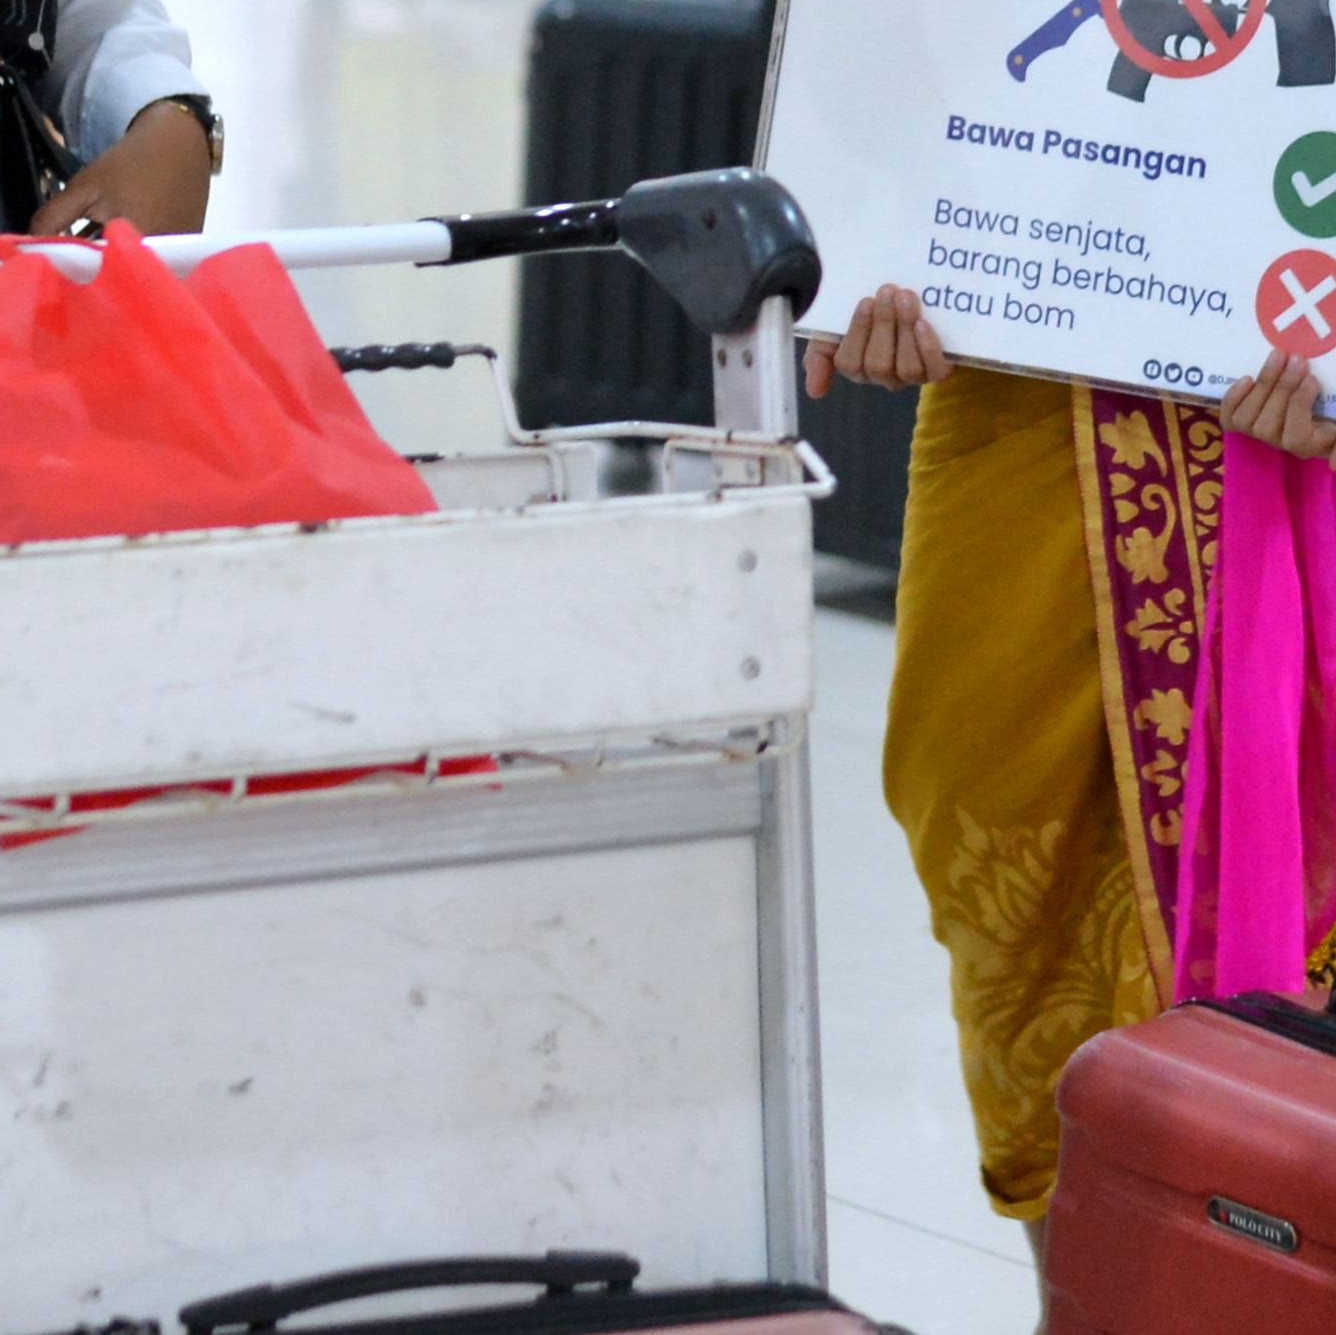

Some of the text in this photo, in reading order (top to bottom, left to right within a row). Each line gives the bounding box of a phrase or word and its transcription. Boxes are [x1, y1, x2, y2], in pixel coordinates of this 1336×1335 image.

[946, 114, 1208, 181] Bawa Pasangan
[933, 198, 1152, 263] Bawa senjata,
[921, 284, 1076, 331] atau bom
[927, 238, 1234, 319] barang berbahaya,
[1229, 1212, 1282, 1243] POLO CITY
